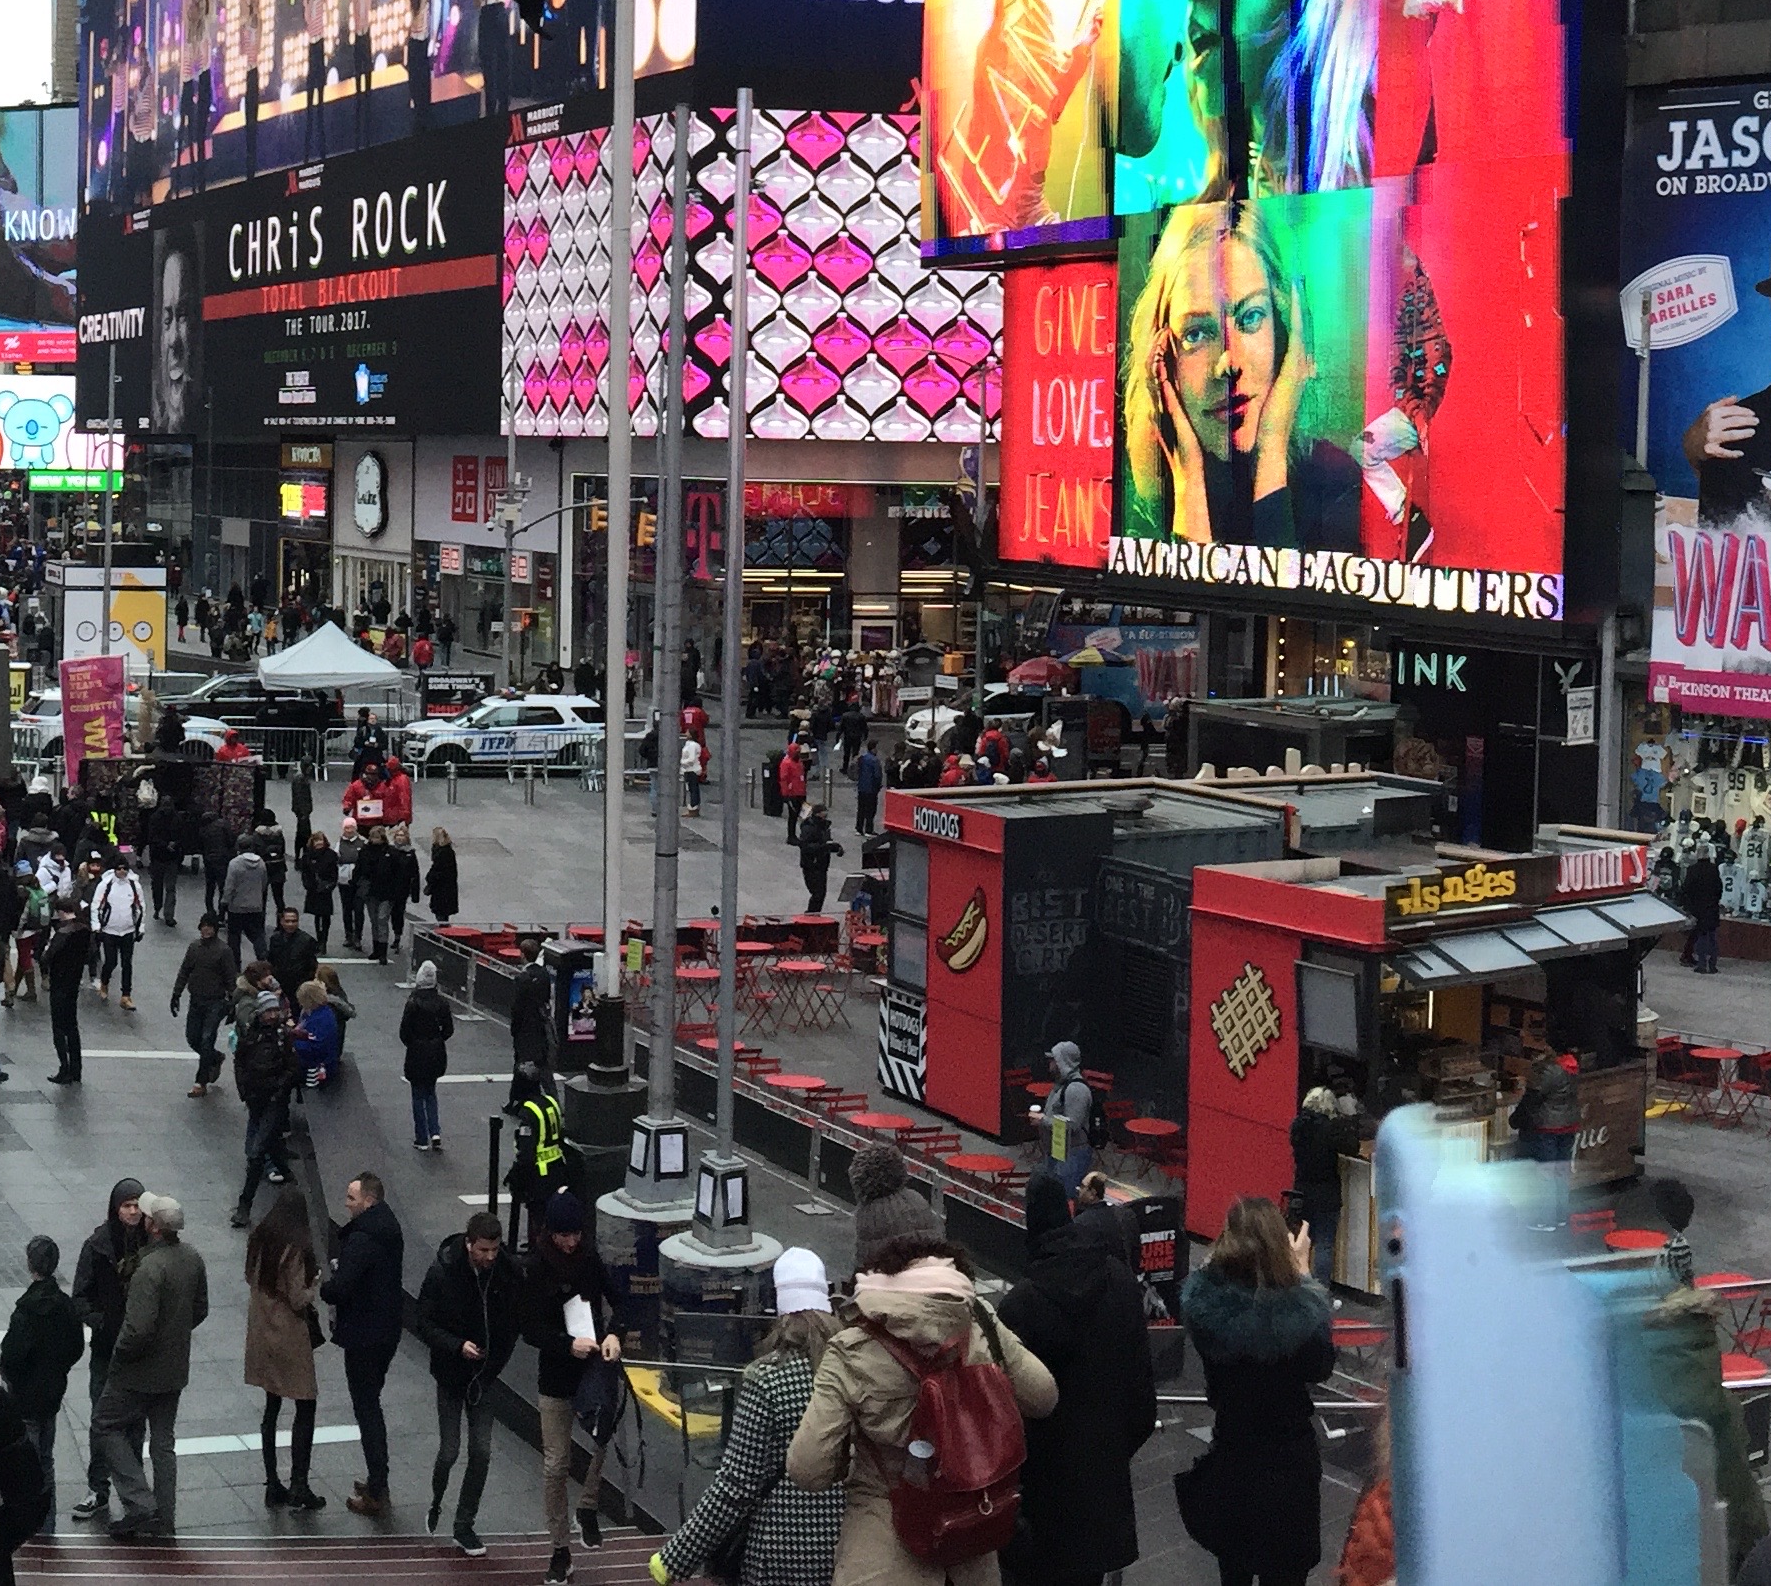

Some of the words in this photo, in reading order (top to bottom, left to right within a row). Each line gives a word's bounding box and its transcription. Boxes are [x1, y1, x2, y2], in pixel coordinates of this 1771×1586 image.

[1657, 178, 1687, 195] ON
[5, 209, 77, 241] KNOW
[262, 283, 305, 313] TOTAL
[318, 268, 400, 307] BLACKOUT
[1657, 284, 1694, 305] SARA
[285, 318, 302, 336] THE
[310, 311, 370, 333] TOUR.2017.
[1034, 283, 1114, 357] GIVE.
[1111, 536, 1280, 593] AMERICAN
[1396, 648, 1469, 693] INK
[913, 806, 960, 839] HOTDOGS
